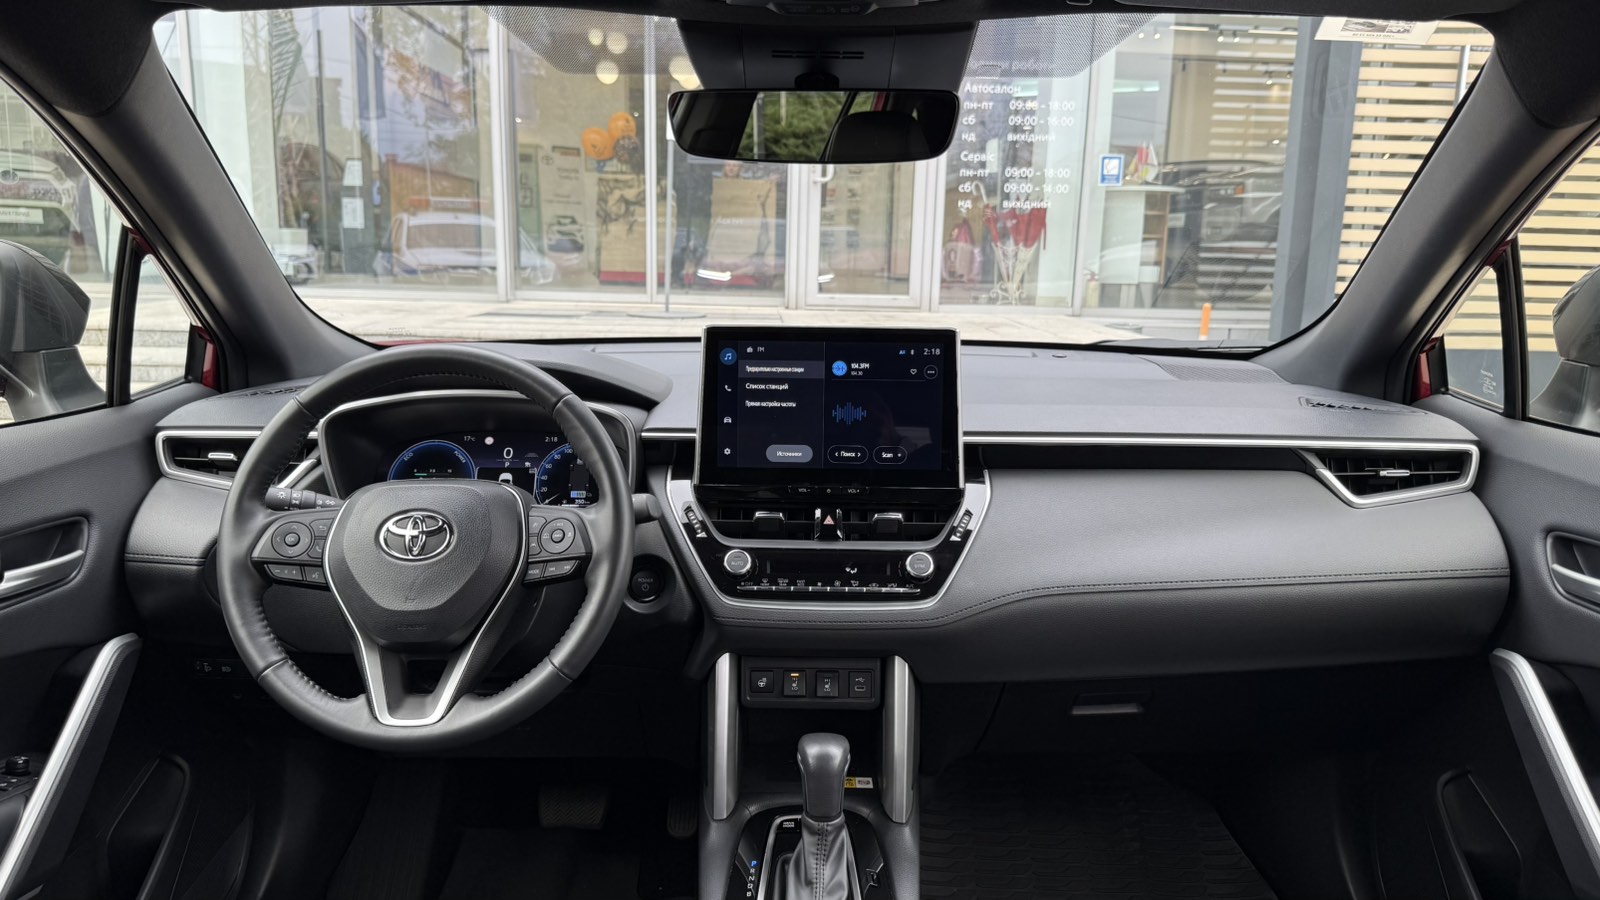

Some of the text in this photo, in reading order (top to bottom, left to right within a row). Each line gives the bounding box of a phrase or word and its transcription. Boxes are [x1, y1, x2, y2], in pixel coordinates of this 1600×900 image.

[964, 82, 1021, 94] Автосалон
[963, 102, 994, 110] пн-пт
[962, 115, 976, 125] сб
[1008, 116, 1037, 126] 09:00
[962, 133, 976, 142] нд
[1004, 167, 1034, 178] 09:00
[958, 183, 972, 193] сб
[1003, 183, 1033, 193] 09:00
[503, 447, 514, 459] 0
